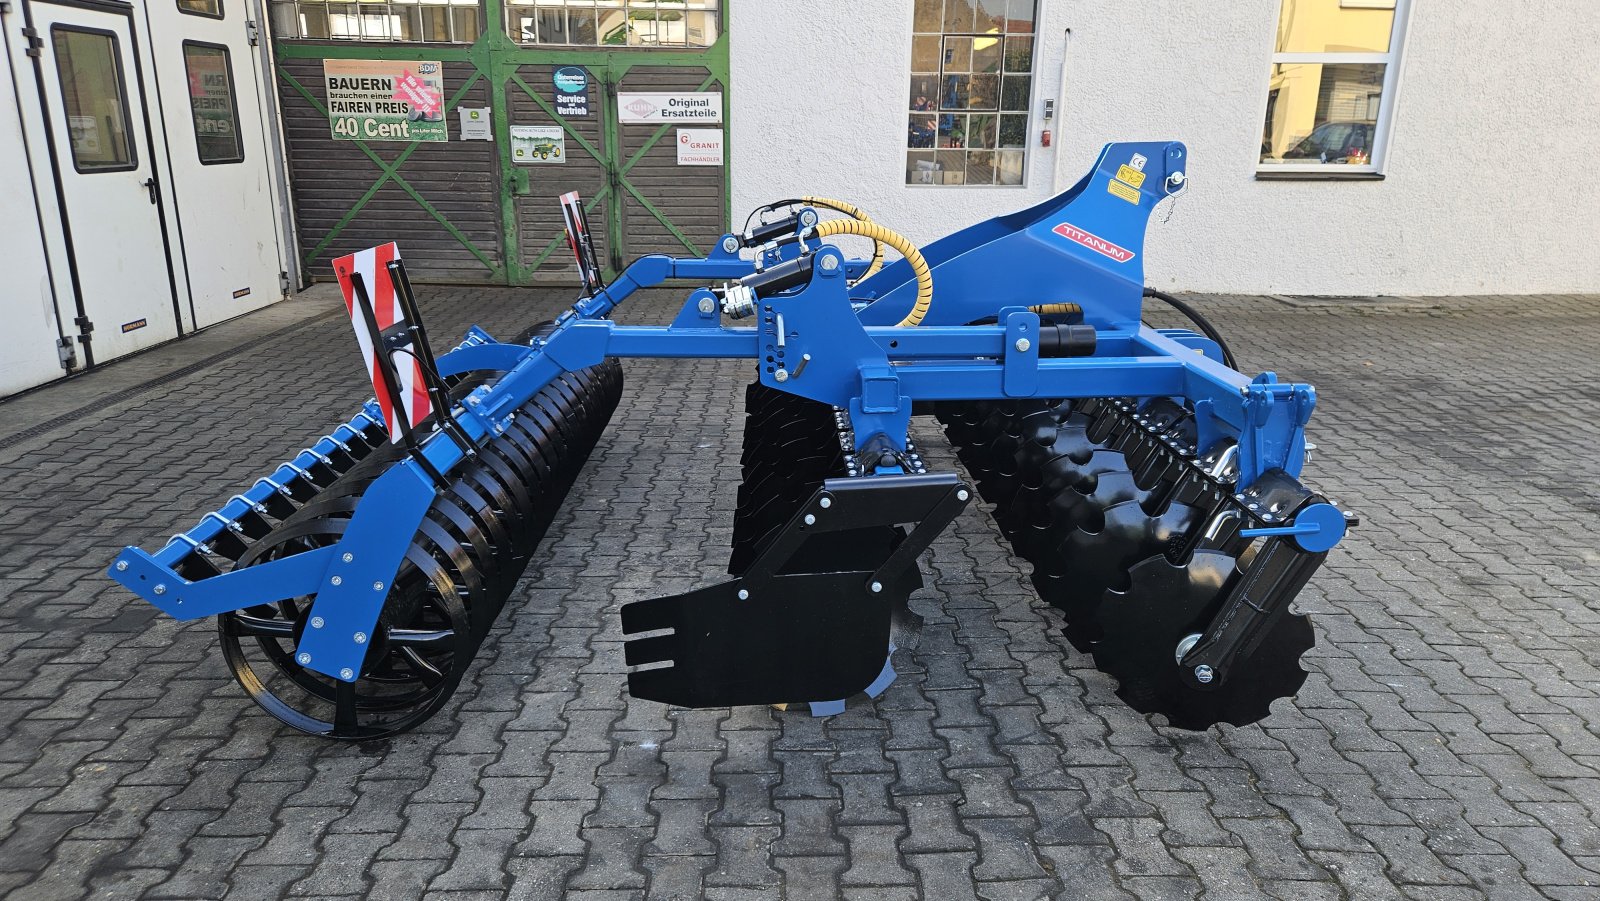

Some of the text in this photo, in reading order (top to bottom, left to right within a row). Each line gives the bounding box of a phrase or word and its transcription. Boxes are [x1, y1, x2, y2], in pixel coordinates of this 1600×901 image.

[419, 63, 437, 73] BDM
[328, 77, 392, 91] BAUERN
[330, 91, 393, 100] brauchen einen
[415, 86, 436, 105] wieder
[557, 94, 586, 103] Service
[330, 101, 409, 114] FAIREN PREIS
[627, 103, 654, 112] KUHN
[668, 98, 709, 108] Original
[557, 106, 587, 115] Vertrieb
[661, 109, 717, 118] Ersatzteile
[335, 117, 410, 138] 40 Cent
[681, 135, 688, 144] G
[1063, 225, 1125, 260] TITANUM
